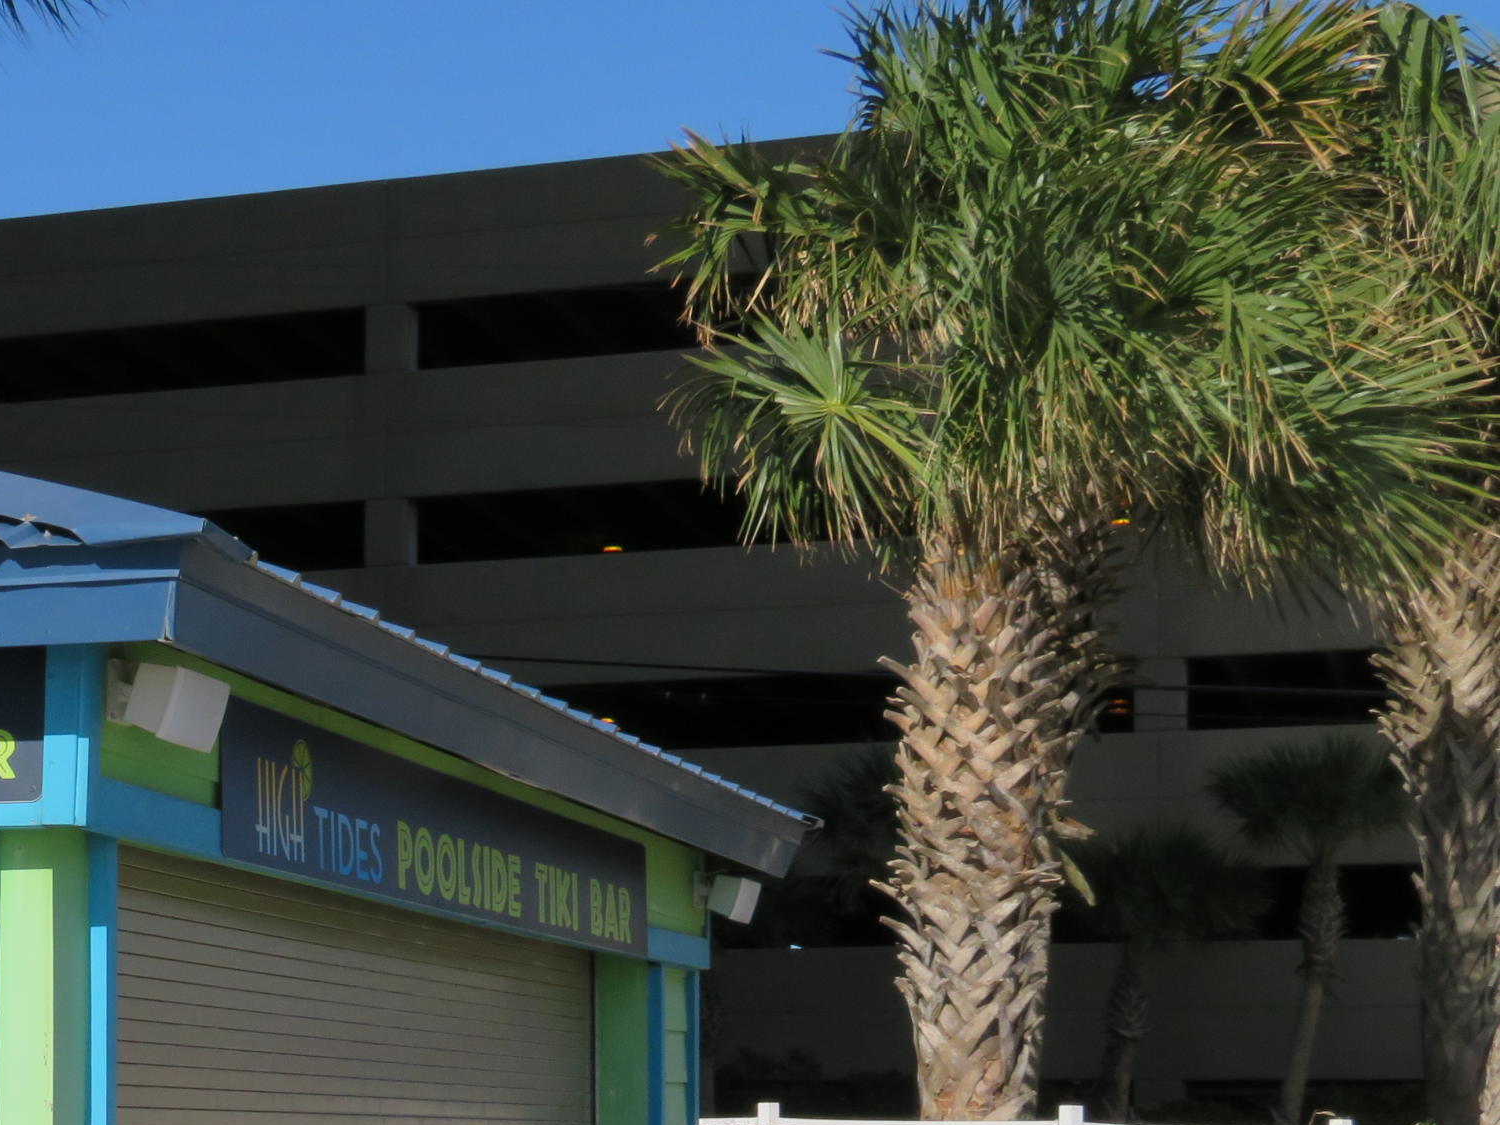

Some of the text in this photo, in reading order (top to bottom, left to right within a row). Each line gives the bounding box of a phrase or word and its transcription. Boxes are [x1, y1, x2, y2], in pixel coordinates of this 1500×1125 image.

[254, 756, 632, 945] HIGH TIDES POOLSIDE TIKI BAR
